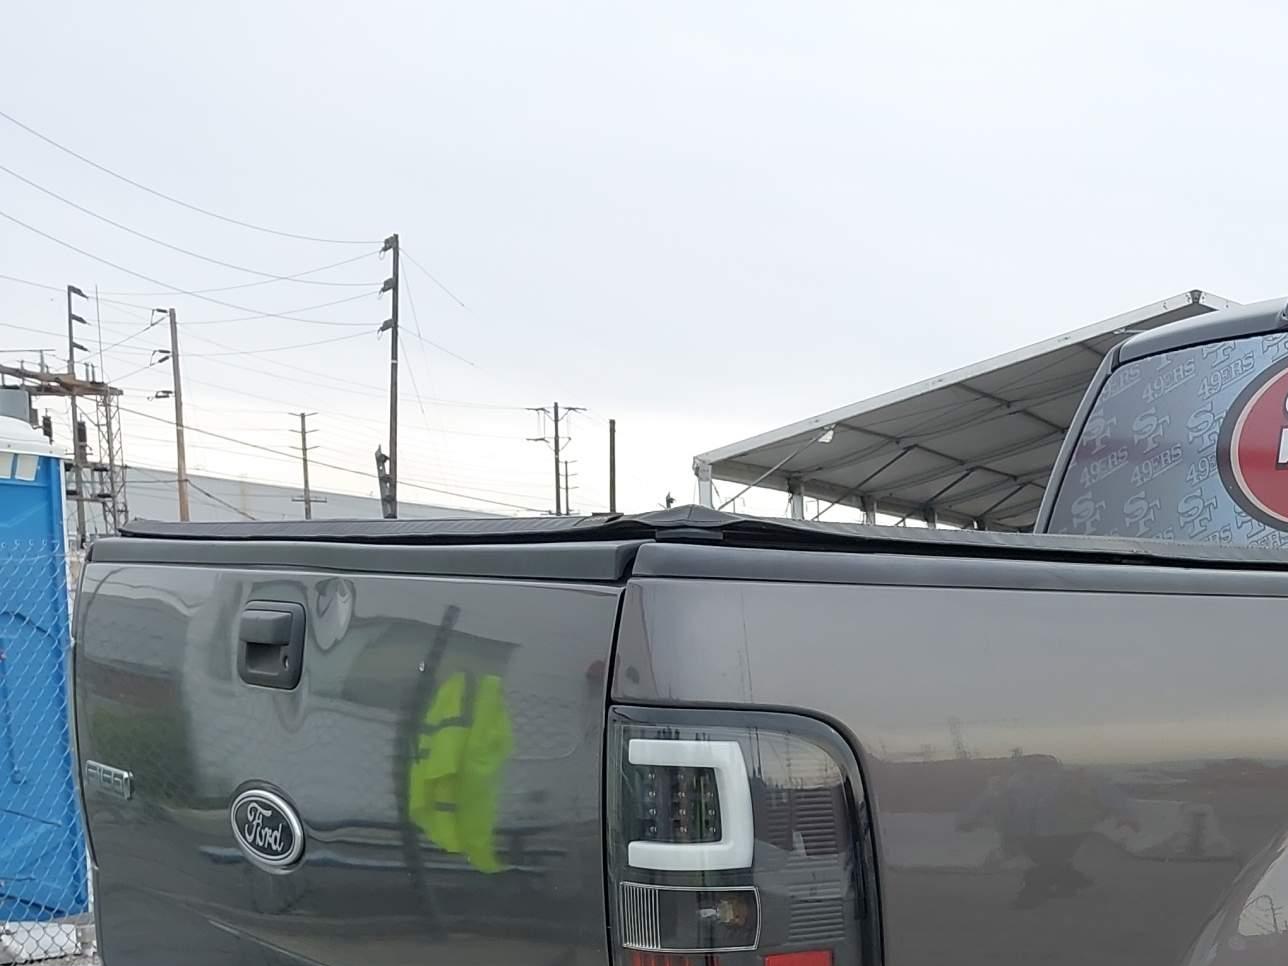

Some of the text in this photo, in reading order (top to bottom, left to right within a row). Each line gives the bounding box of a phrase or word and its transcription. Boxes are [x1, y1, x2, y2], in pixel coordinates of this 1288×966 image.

[1142, 357, 1195, 401] 49ERS
[1197, 351, 1255, 400] 49ERS
[1079, 446, 1129, 488] 49ERS
[1130, 443, 1183, 488] 49ERS
[244, 802, 285, 852] Ford
